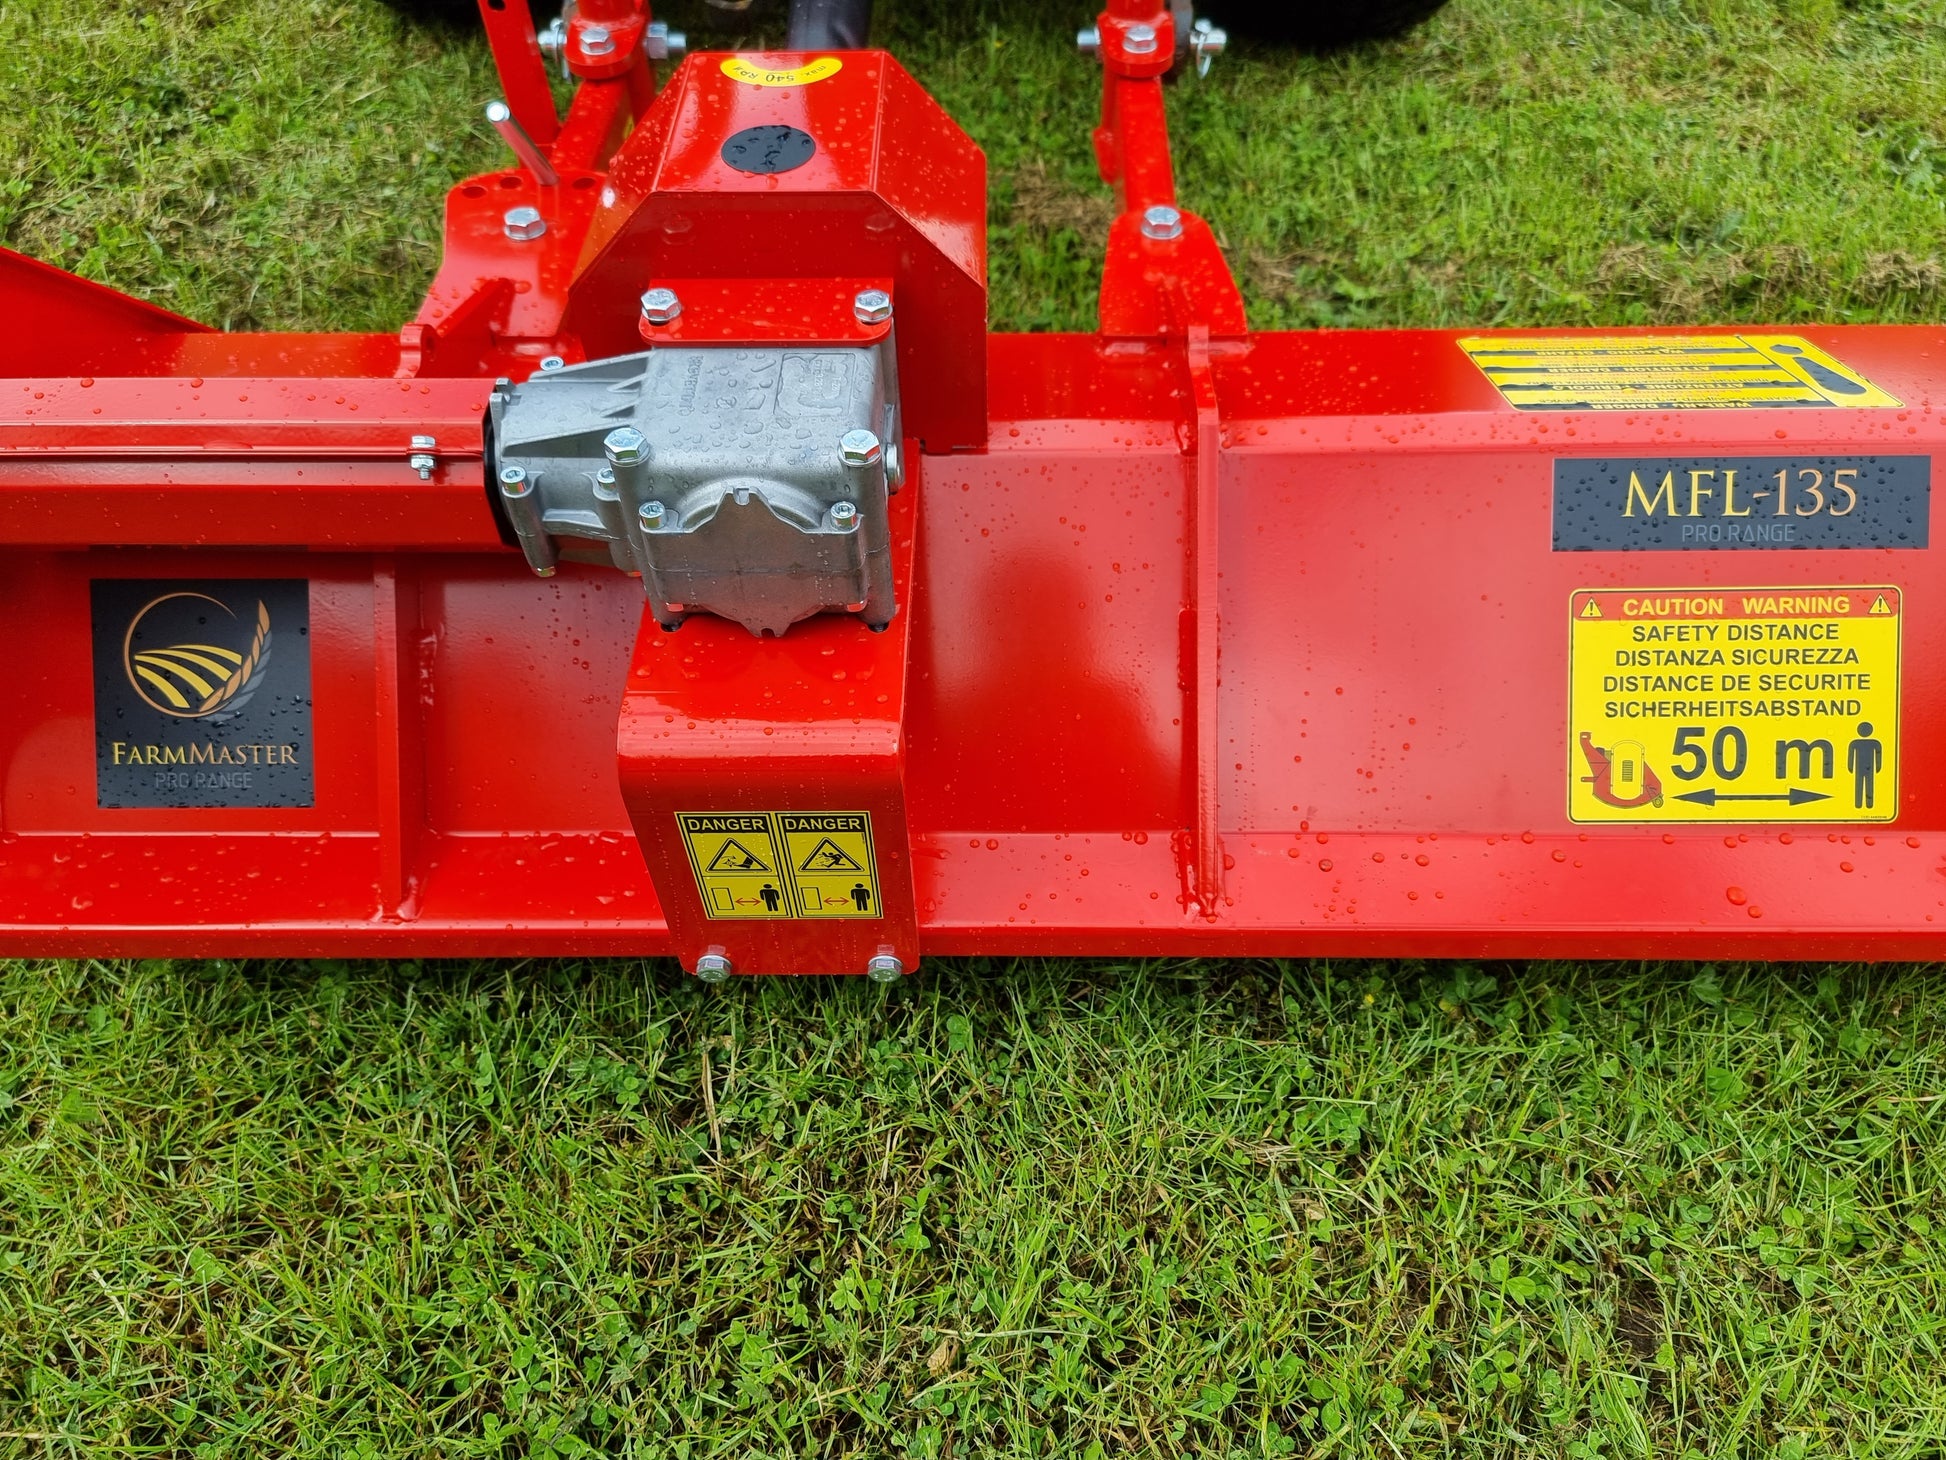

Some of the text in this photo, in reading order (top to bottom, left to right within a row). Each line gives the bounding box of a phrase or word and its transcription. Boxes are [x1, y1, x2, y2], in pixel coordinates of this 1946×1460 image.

[765, 73, 795, 82] 540
[1644, 382, 1744, 390] ATTENZIONE
[1621, 468, 1858, 517] MFL-135
[1682, 523, 1795, 543] PRO RANGE
[1623, 596, 1850, 616] CAUTION WARNING
[1632, 623, 1839, 642] SAFETY DISTANCE
[1615, 648, 1859, 667] DISTANZA SICUREZZA
[1603, 673, 1871, 692] DISTANCE DE SECURITE
[1604, 699, 1862, 718] SICHERHEITSABSTAND
[1670, 725, 1834, 781] 50 m
[155, 772, 253, 788] PRO RANGE
[687, 818, 766, 831] DANGER
[784, 817, 862, 830] DANGER
